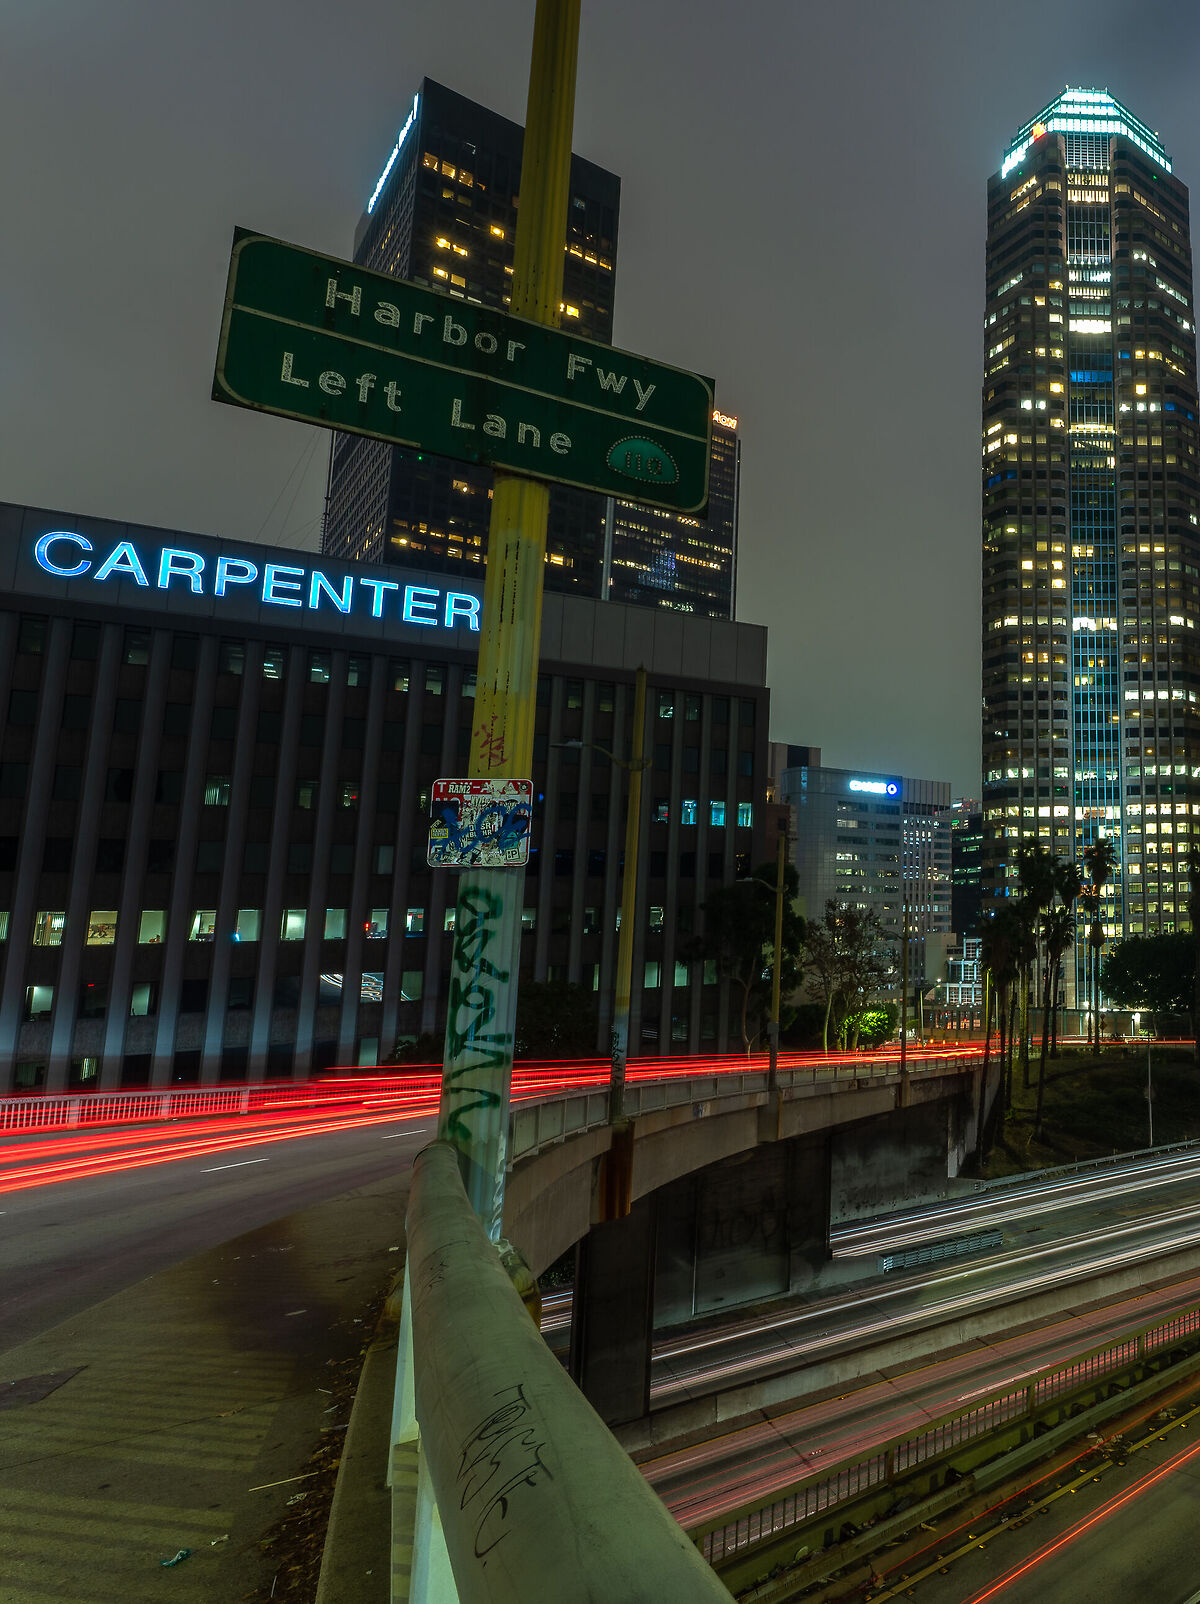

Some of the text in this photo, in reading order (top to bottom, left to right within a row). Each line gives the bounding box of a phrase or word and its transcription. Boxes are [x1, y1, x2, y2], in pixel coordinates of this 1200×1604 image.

[324, 278, 657, 411] Harbor Fwy
[281, 352, 572, 455] Left Lane
[625, 451, 661, 475] 110
[34, 531, 481, 631] CARPENTER
